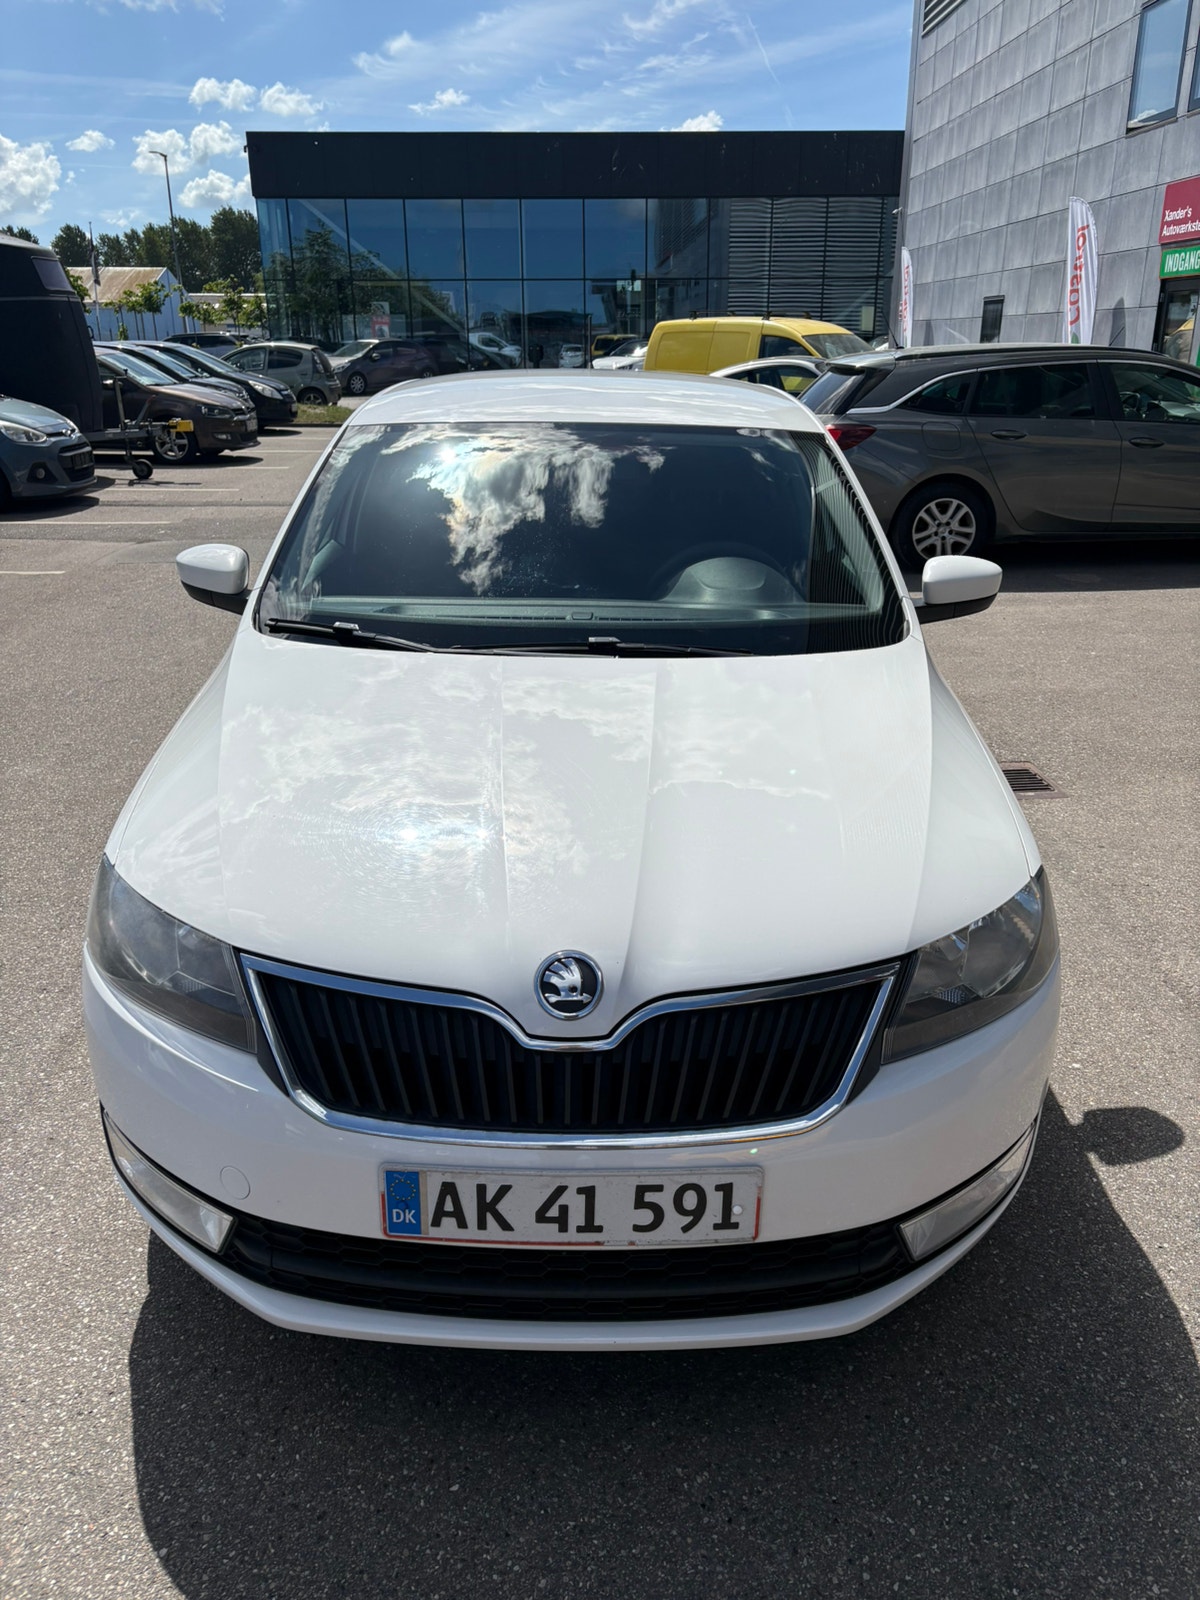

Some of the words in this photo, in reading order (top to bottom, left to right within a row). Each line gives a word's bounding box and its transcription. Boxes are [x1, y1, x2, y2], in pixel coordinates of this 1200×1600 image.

[1163, 205, 1193, 222] Xander's
[1164, 250, 1200, 273] INDGANG
[392, 1208, 417, 1224] DK
[430, 1181, 515, 1232] AK
[535, 1184, 604, 1234] 41
[632, 1182, 740, 1234] 591
